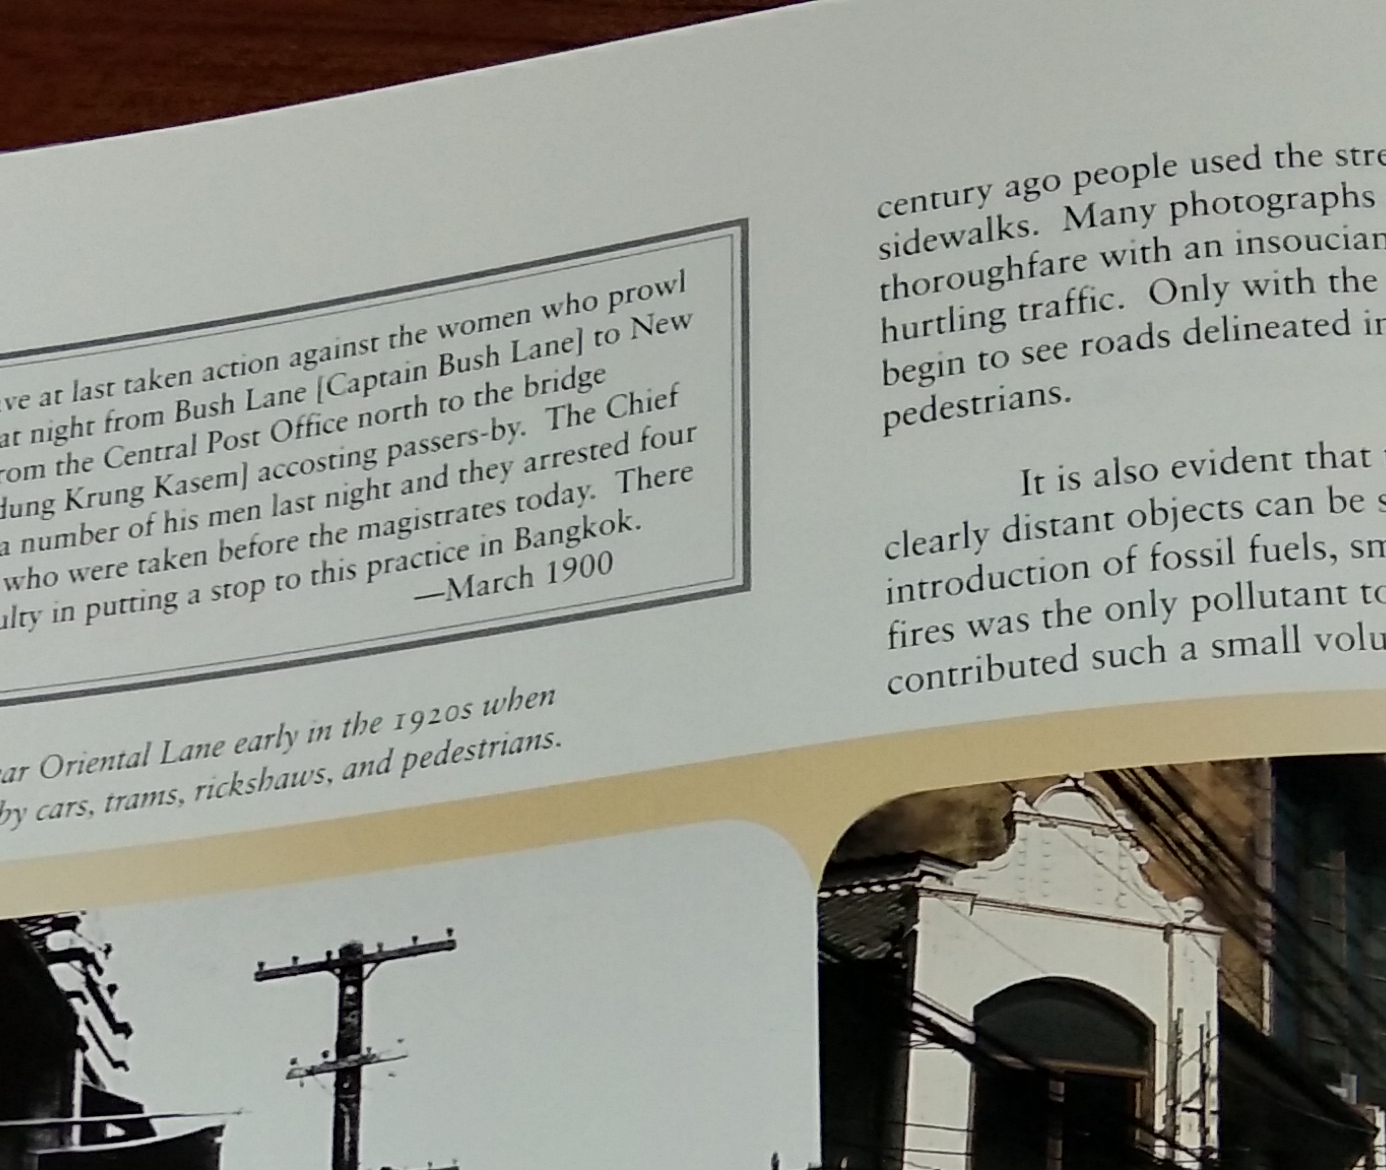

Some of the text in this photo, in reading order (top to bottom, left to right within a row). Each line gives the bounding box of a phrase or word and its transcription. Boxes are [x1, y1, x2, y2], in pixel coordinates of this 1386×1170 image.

[876, 182, 994, 220] century
[1004, 173, 1062, 204] ago
[1073, 150, 1178, 197] people
[1190, 142, 1262, 177] used
[1274, 140, 1324, 170] the
[38, 388, 64, 409] at
[72, 378, 116, 404] last
[124, 366, 193, 396] taken
[201, 352, 280, 384] action
[289, 335, 380, 373] against
[388, 322, 428, 351] the
[436, 307, 532, 340] women
[540, 290, 599, 321] who
[608, 267, 686, 316] prowl
[882, 350, 966, 389] begin
[977, 349, 1010, 373] to
[1021, 340, 1069, 367] see
[1080, 319, 1171, 359] roads
[1182, 306, 1352, 347] delineated
[64, 484, 145, 513] Krung
[153, 460, 248, 500] Kasem]
[257, 445, 378, 484] accosting
[387, 415, 527, 469] passers-by.
[544, 401, 597, 432] The
[605, 380, 680, 420] Chief
[882, 383, 1072, 439] pedestrians.
[2, 564, 59, 593] who
[67, 560, 129, 585] were
[137, 546, 208, 576] taken
[218, 531, 300, 564] before
[308, 521, 349, 550] the
[357, 498, 507, 542] magistrates
[515, 480, 597, 514] today.
[614, 464, 694, 495] There
[547, 549, 614, 586] 1900
[886, 555, 1091, 607] introduction
[1102, 542, 1139, 577] of
[1150, 534, 1236, 573] fossil
[1249, 530, 1338, 567] fuels,
[887, 641, 1079, 697] contributed
[1091, 633, 1167, 671] such
[1180, 640, 1198, 663] a
[1211, 622, 1302, 660] small
[39, 740, 153, 781] Oriental
[159, 738, 226, 766] Lane
[233, 721, 299, 757] early
[307, 724, 333, 745] in
[341, 709, 384, 740] the
[393, 701, 474, 735] 1920s
[482, 684, 556, 718] when
[35, 798, 95, 823] cars,
[104, 787, 185, 814] trams,
[194, 765, 334, 803] rickshaws,
[341, 746, 395, 782] and
[400, 730, 562, 780] pedestrians.
